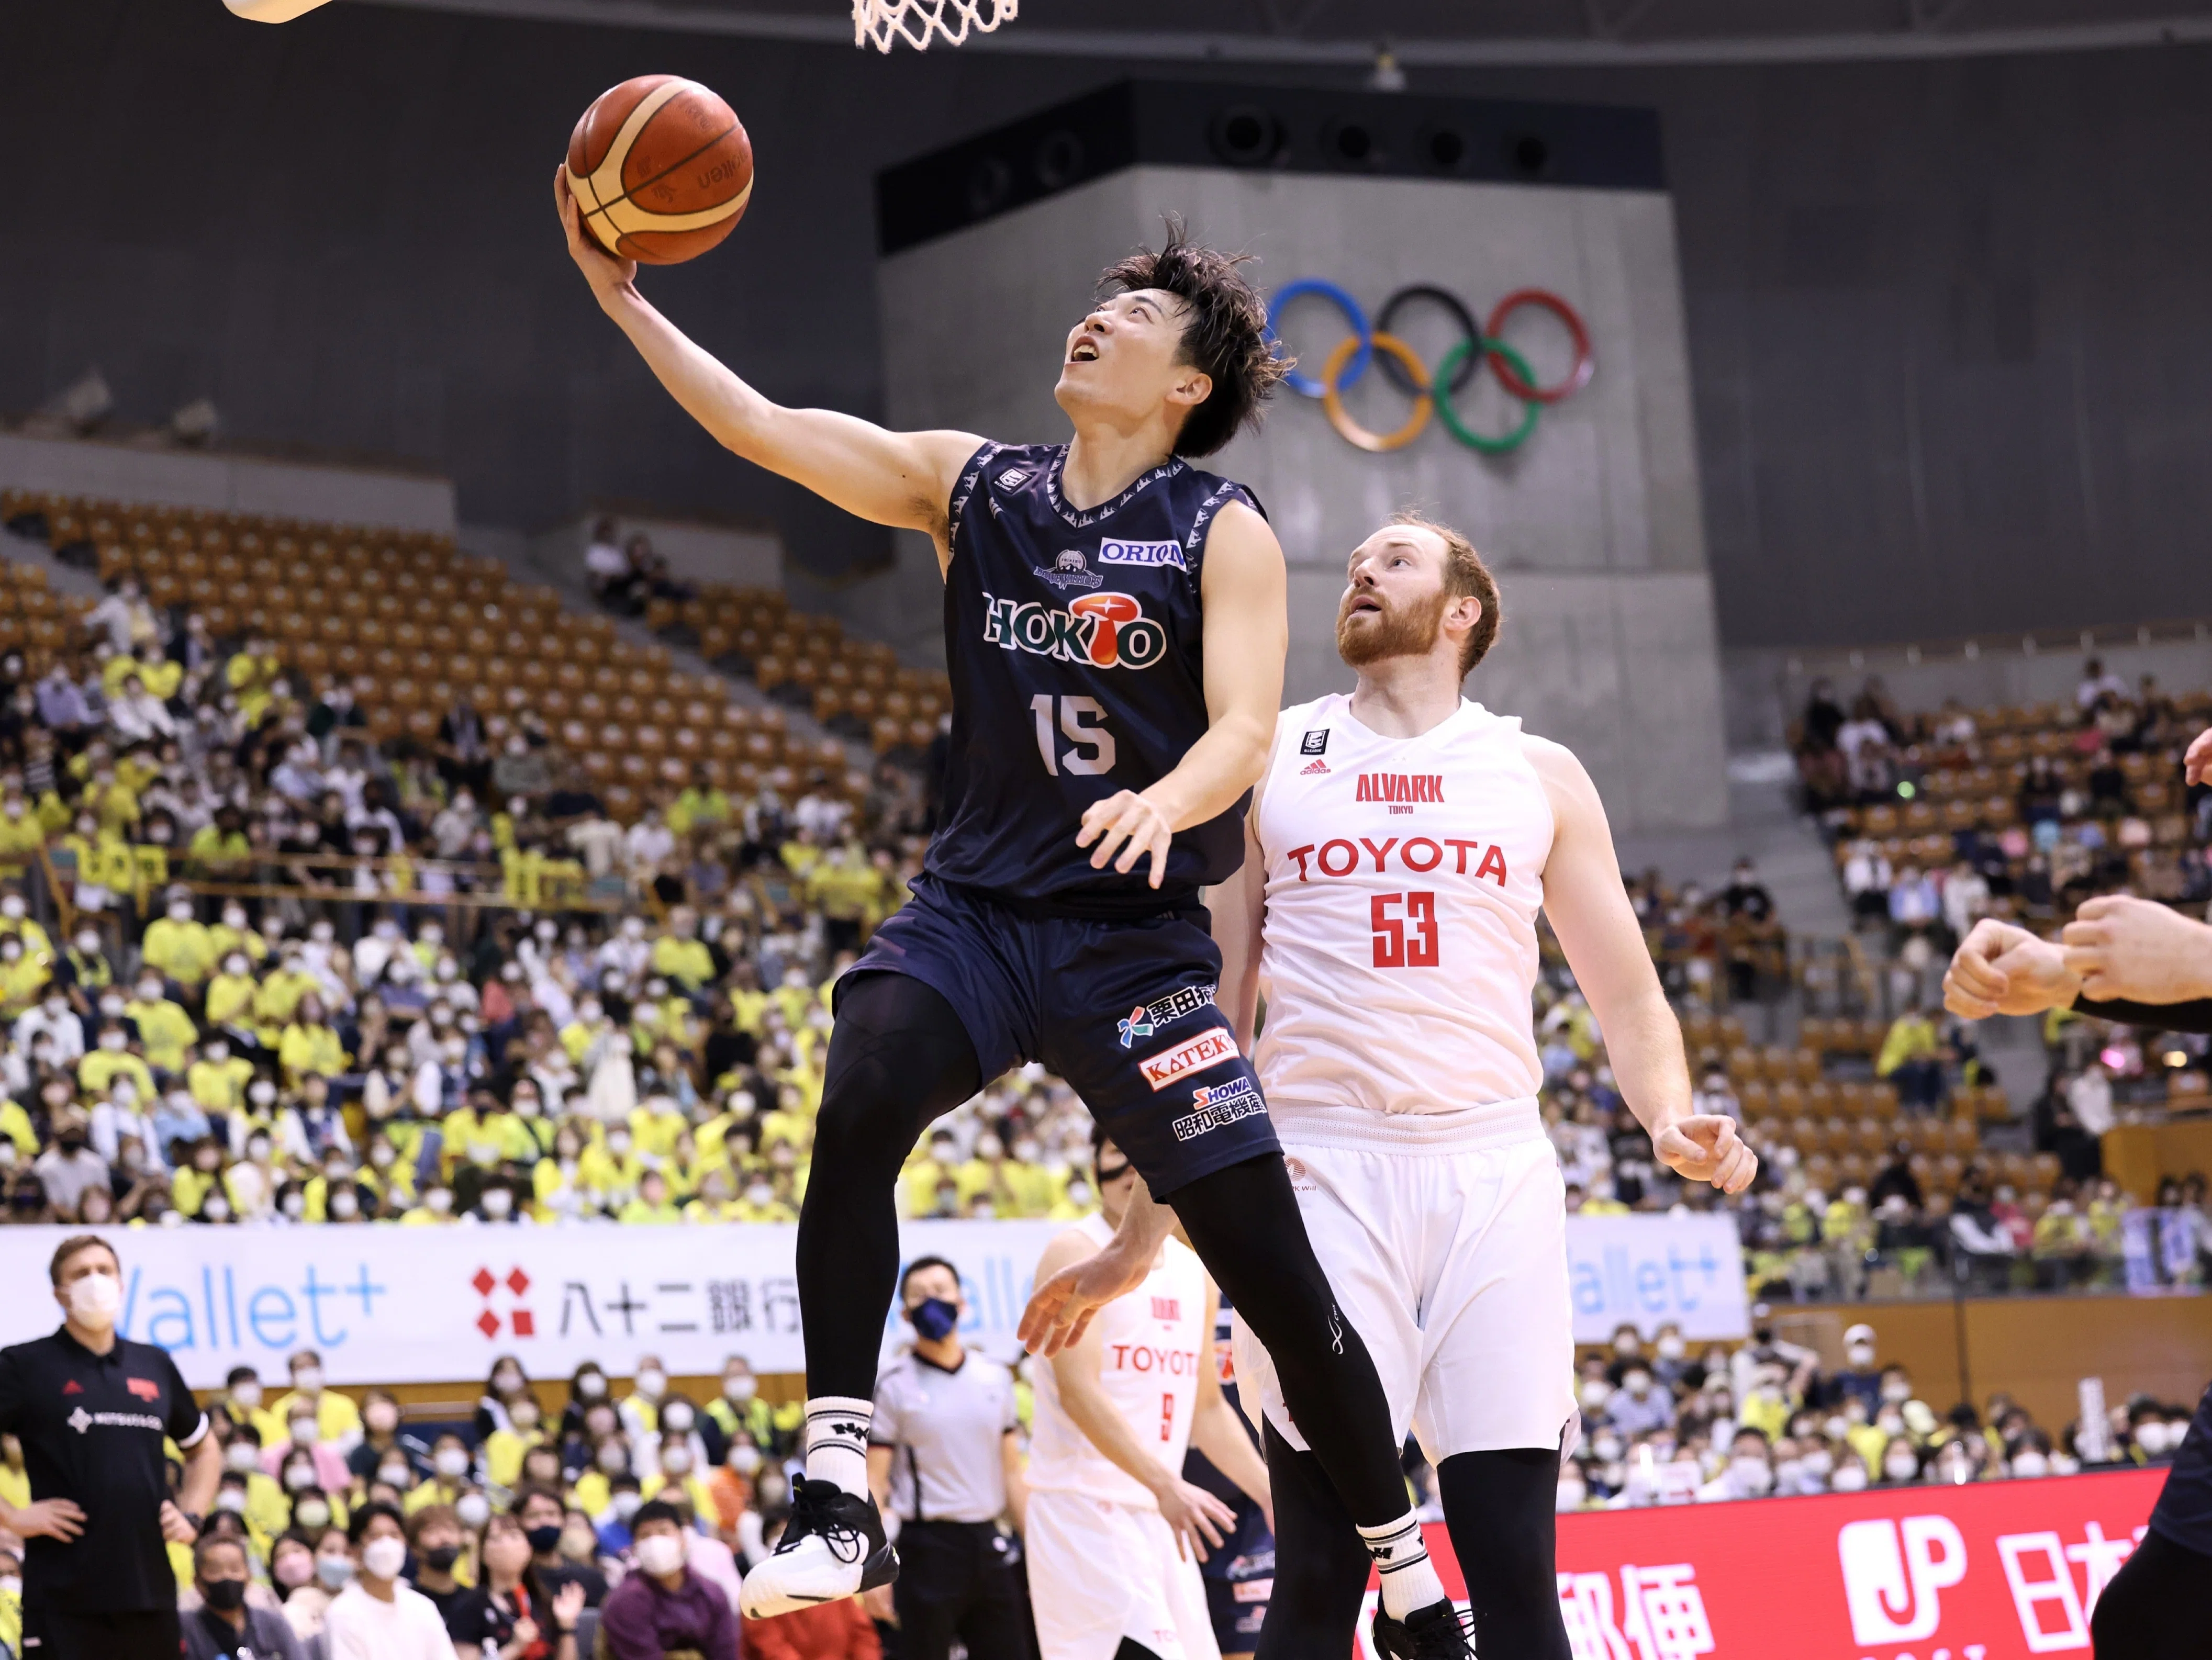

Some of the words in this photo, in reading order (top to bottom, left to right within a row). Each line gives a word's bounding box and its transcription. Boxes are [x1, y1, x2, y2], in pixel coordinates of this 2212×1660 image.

[1102, 543, 1184, 566] ORION
[982, 592, 1167, 670] HOKTO
[1030, 693, 1116, 776] 15
[1356, 773, 1445, 802] ALVARK
[1388, 805, 1413, 814] TOKYO
[1287, 837, 1507, 887] TOYOTA
[1371, 892, 1439, 968] 53
[1192, 1076, 1252, 1110] SHOWA
[1112, 1344, 1199, 1377] TOYOT
[1995, 1520, 2149, 1654] 日本
